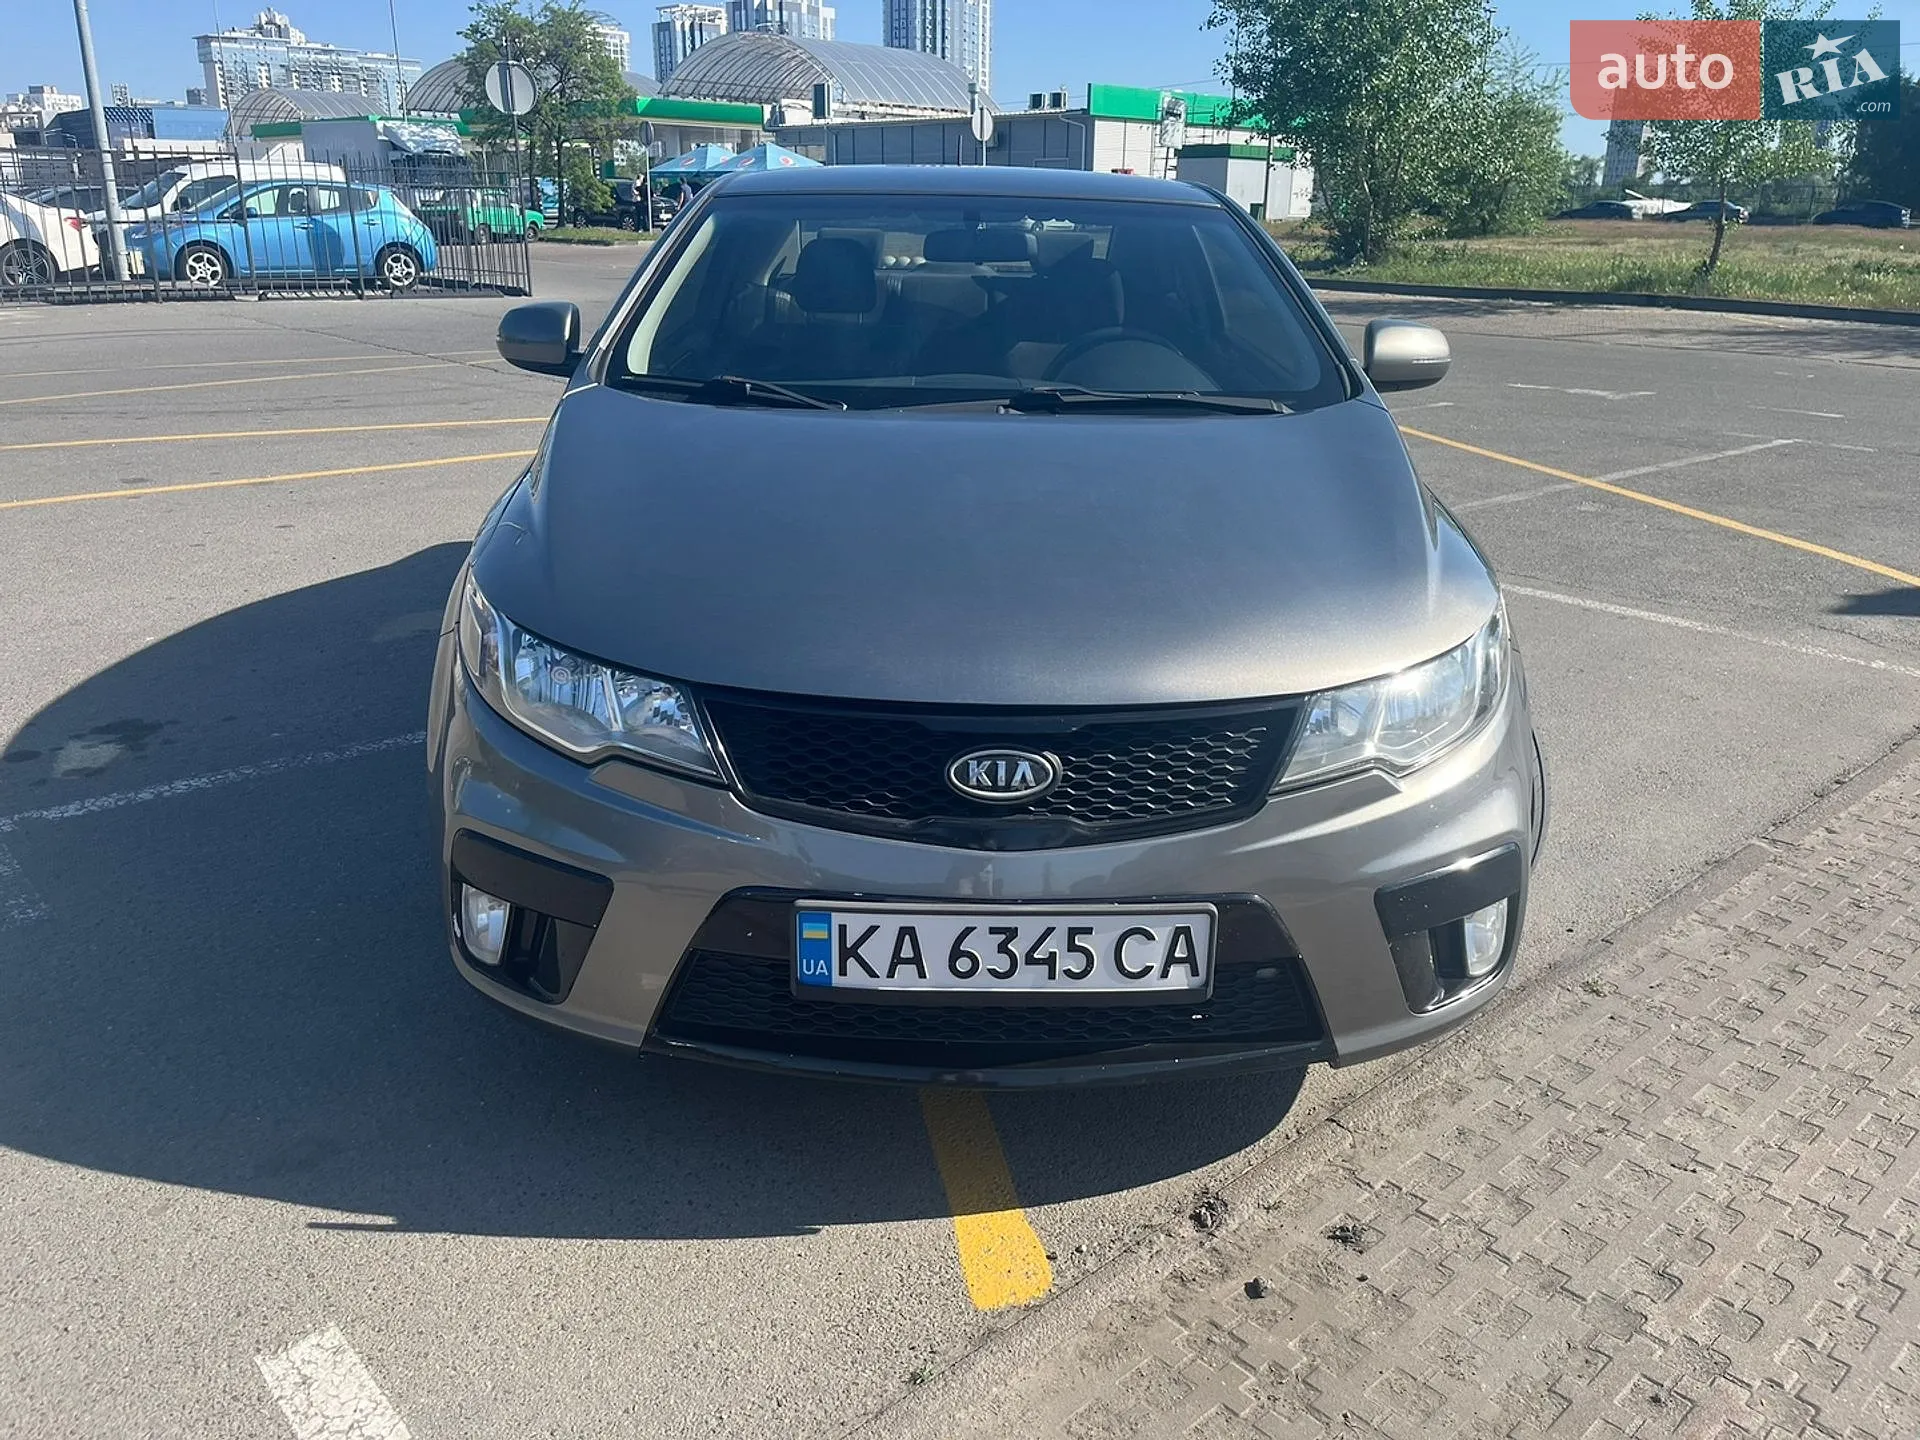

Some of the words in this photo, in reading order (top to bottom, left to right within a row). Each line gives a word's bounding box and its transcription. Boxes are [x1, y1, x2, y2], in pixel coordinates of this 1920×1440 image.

[967, 759, 1036, 787] KIA
[838, 924, 928, 980] KA
[948, 926, 1096, 981] 6345
[1113, 925, 1200, 980] CA
[802, 958, 830, 977] UA
